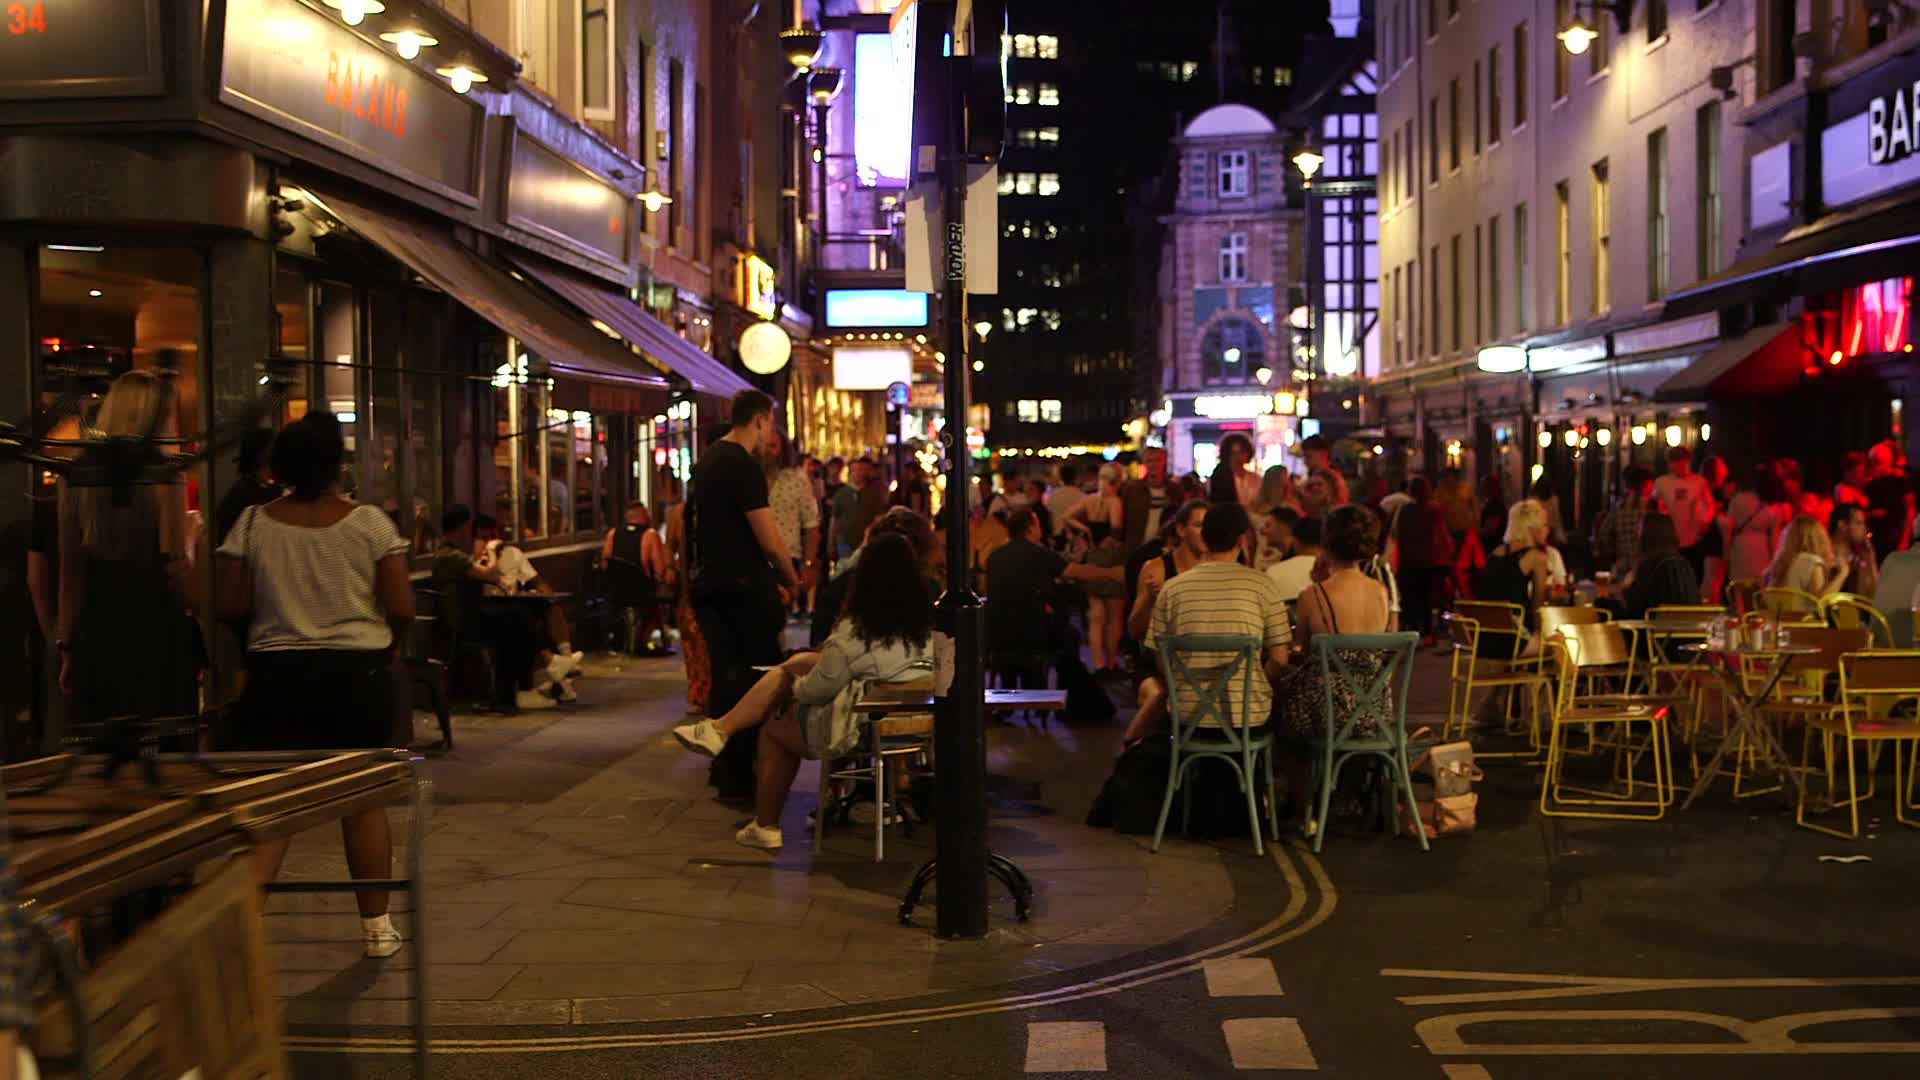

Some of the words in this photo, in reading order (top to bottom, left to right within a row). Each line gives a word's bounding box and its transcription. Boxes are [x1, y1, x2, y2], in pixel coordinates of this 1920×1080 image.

[7, 2, 48, 34] 34
[325, 49, 409, 139] BALANS
[947, 222, 965, 281] VOYDER
